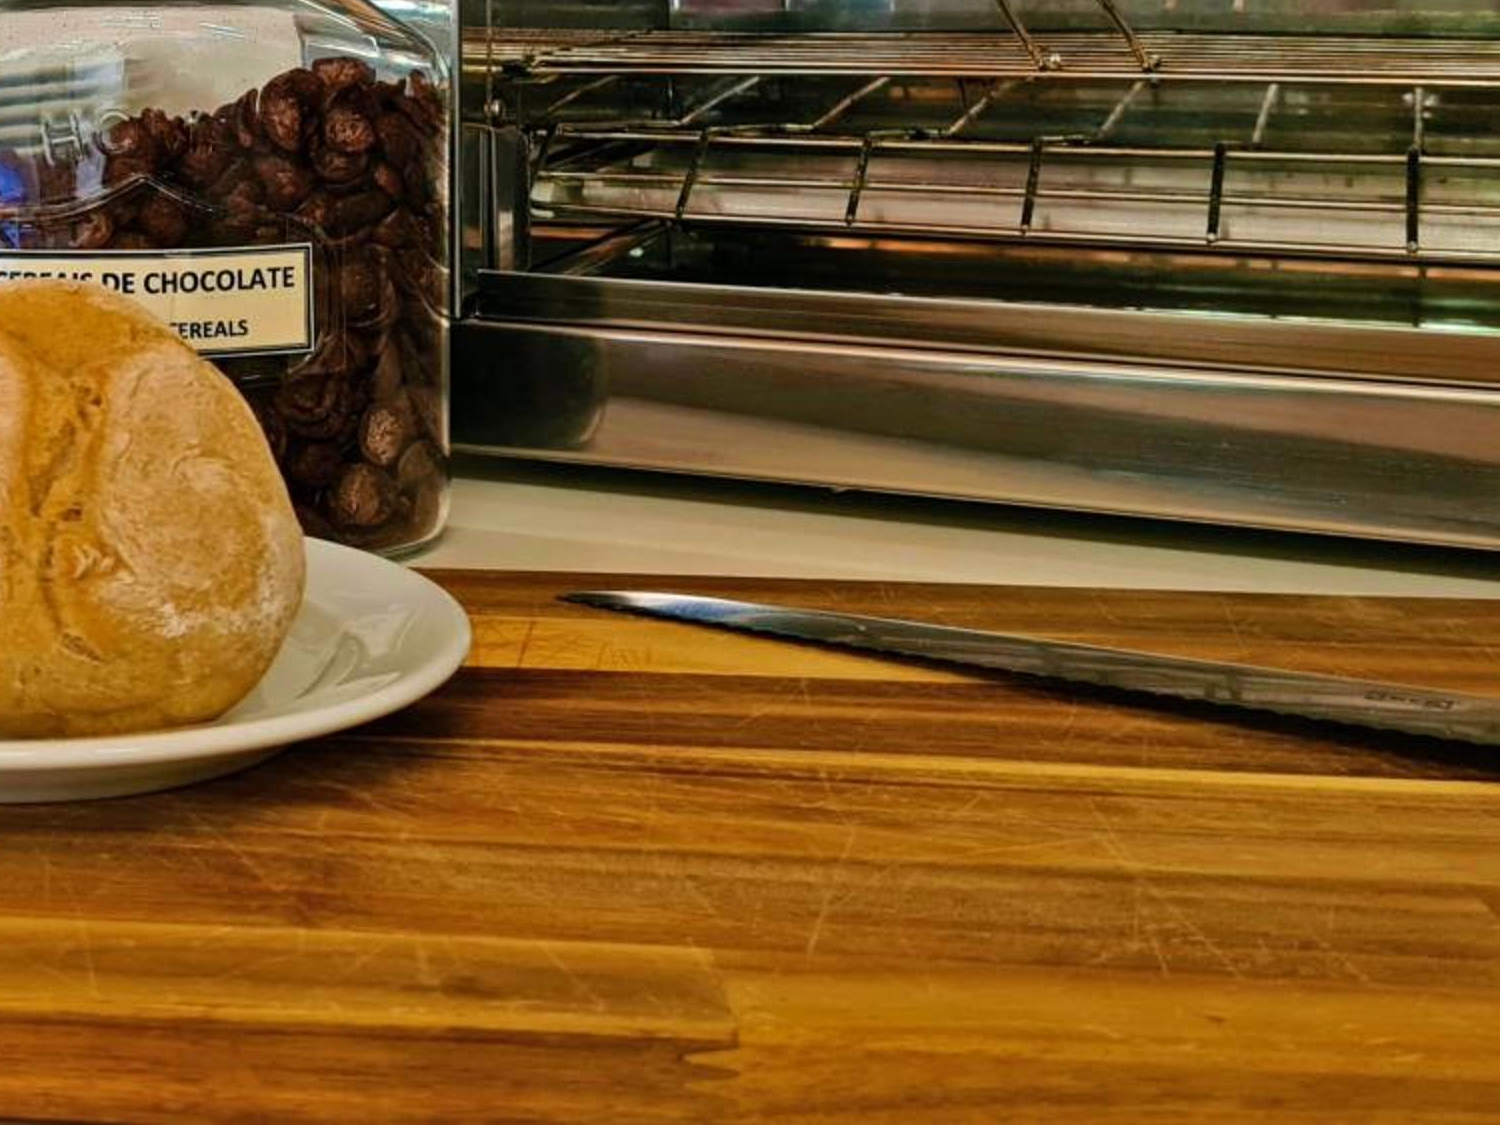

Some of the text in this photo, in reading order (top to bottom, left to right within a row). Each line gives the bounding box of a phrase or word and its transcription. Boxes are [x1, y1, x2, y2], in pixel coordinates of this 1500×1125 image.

[102, 272, 135, 294] DE
[143, 266, 296, 294] CHOCOLATE
[170, 319, 248, 340] EREALS
